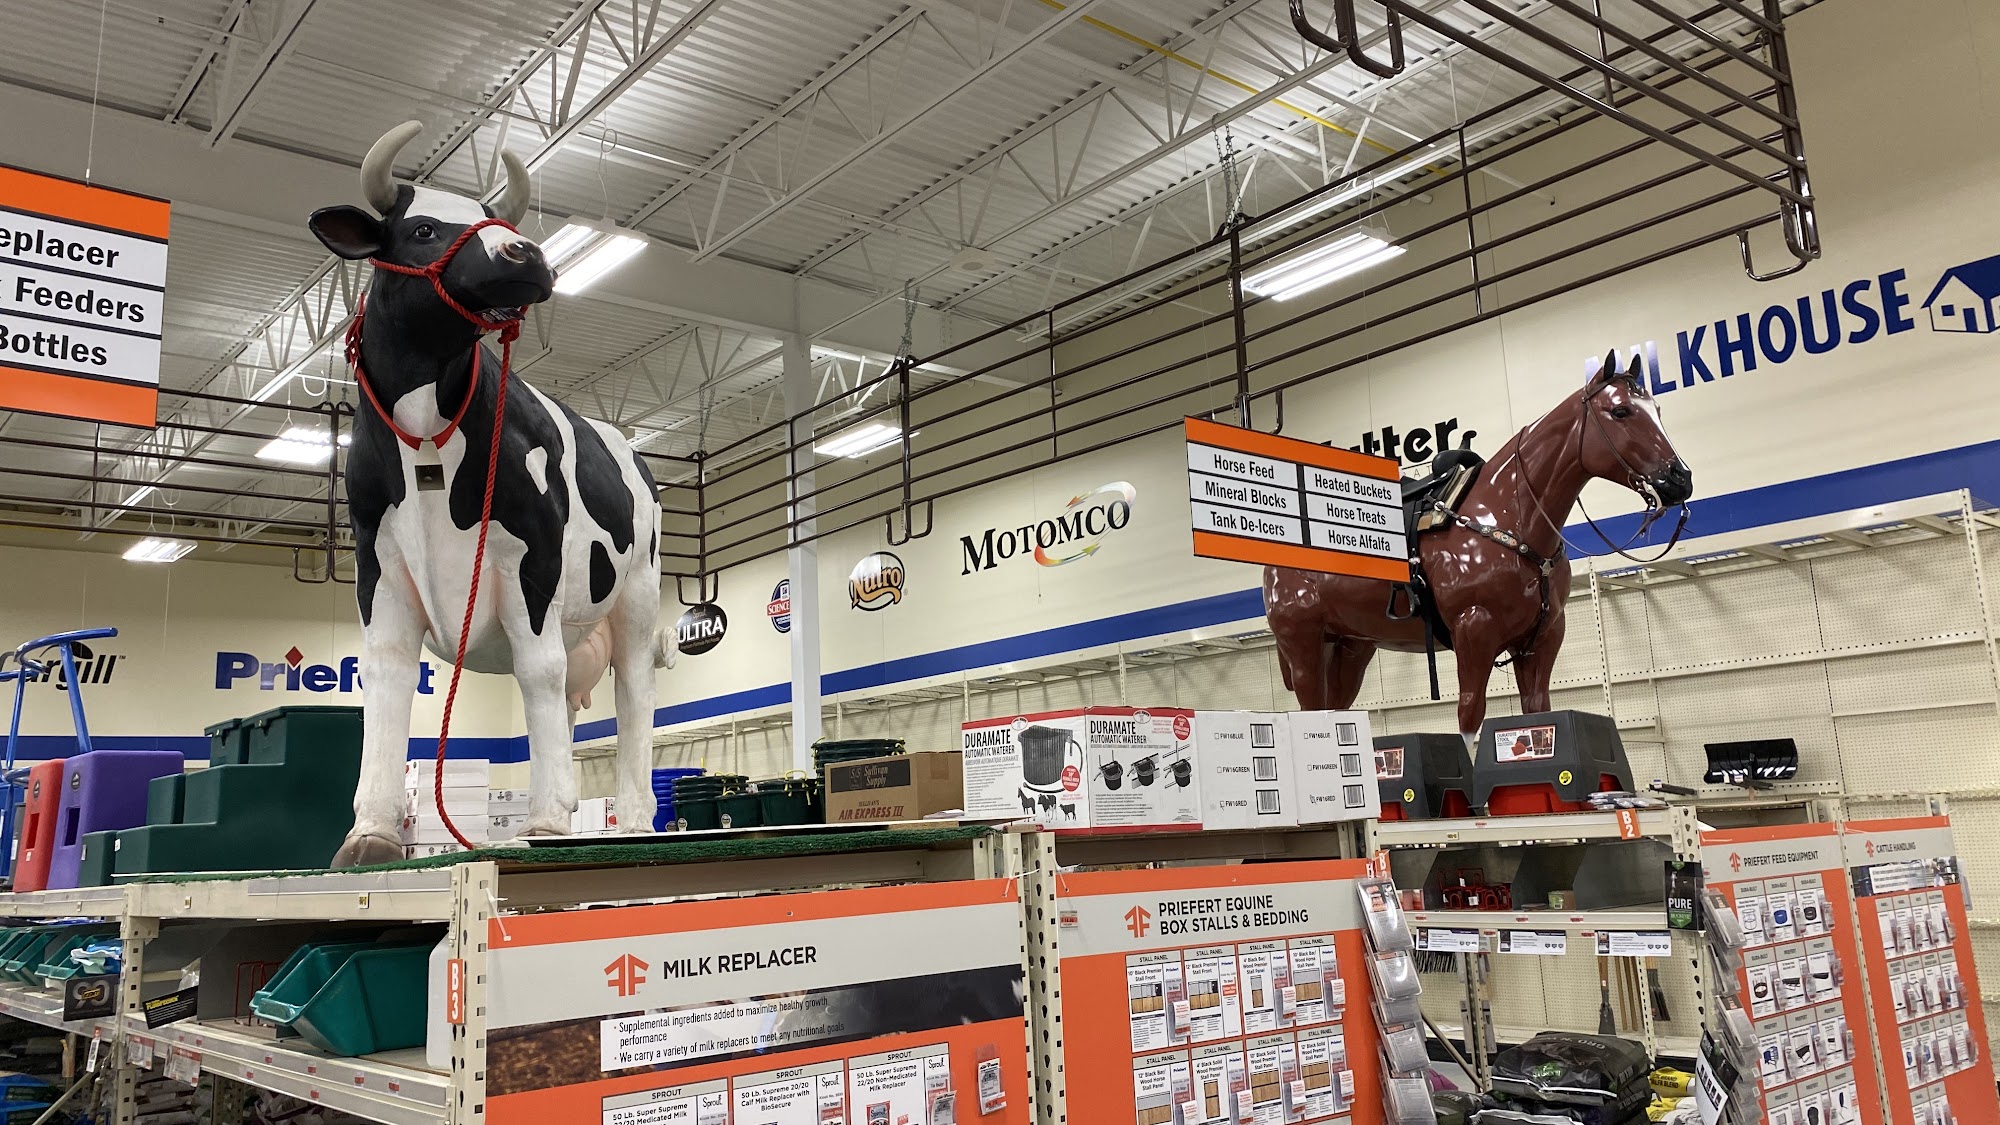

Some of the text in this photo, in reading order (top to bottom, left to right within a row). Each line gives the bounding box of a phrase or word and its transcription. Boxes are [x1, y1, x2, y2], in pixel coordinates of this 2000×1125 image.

[15, 277, 145, 323] Feeders
[1214, 454, 1274, 480] Horse Feed
[1205, 480, 1287, 509] Mineral Blocks
[1315, 474, 1392, 501] Heated Buckets
[1326, 503, 1386, 526] Horse Treats
[1210, 511, 1285, 537] Tank De-Icers
[1328, 529, 1391, 552] Horse Alfalfa
[851, 566, 903, 609] Nutro
[677, 616, 724, 644] ULTRA
[1090, 720, 1136, 734] DURAMATE
[965, 729, 1011, 748] DURAMATE
[1090, 734, 1147, 744] AUTOMATIC WATERER
[965, 745, 1015, 759] AUTOMATIC WATERER
[838, 805, 905, 821] AIR EXPRESS III
[1876, 842, 1916, 853] CATTLE HANDLING
[1743, 850, 1819, 867] PRIEFERT FEED EQUIPMENT
[1158, 894, 1274, 917] PRIEFERT EQUINE
[1668, 897, 1693, 910] PURE
[1160, 909, 1309, 935] BOX STALLS & BEDDING
[662, 946, 818, 980] MILK REPLACER
[450, 962, 459, 1020] B 3
[619, 995, 829, 1034] Supplemental ingredients added to maximize healthy growth
[619, 1033, 668, 1048] performance
[619, 1021, 845, 1065] We carry a variety of milk replacers to meet any nutritional goals
[887, 1051, 912, 1061] SPROUT
[776, 1068, 803, 1080] SPROUT
[875, 1068, 892, 1078] Super
[892, 1064, 917, 1075] Supreme
[875, 1071, 917, 1083] Non-Medicated
[741, 1091, 750, 1099] 50
[762, 1085, 789, 1096] Supreme
[882, 1080, 906, 1090] Replacer
[651, 1088, 682, 1100] SPROUT
[755, 1096, 768, 1105] Milk
[769, 1093, 797, 1105] Replacer
[797, 1090, 810, 1098] with
[612, 1113, 622, 1121] 50
[636, 1108, 657, 1119] Super
[658, 1103, 688, 1115] Supreme
[761, 1101, 791, 1112] BioSecure
[636, 1114, 673, 1125] Medicated
[673, 1111, 688, 1120] Milk
